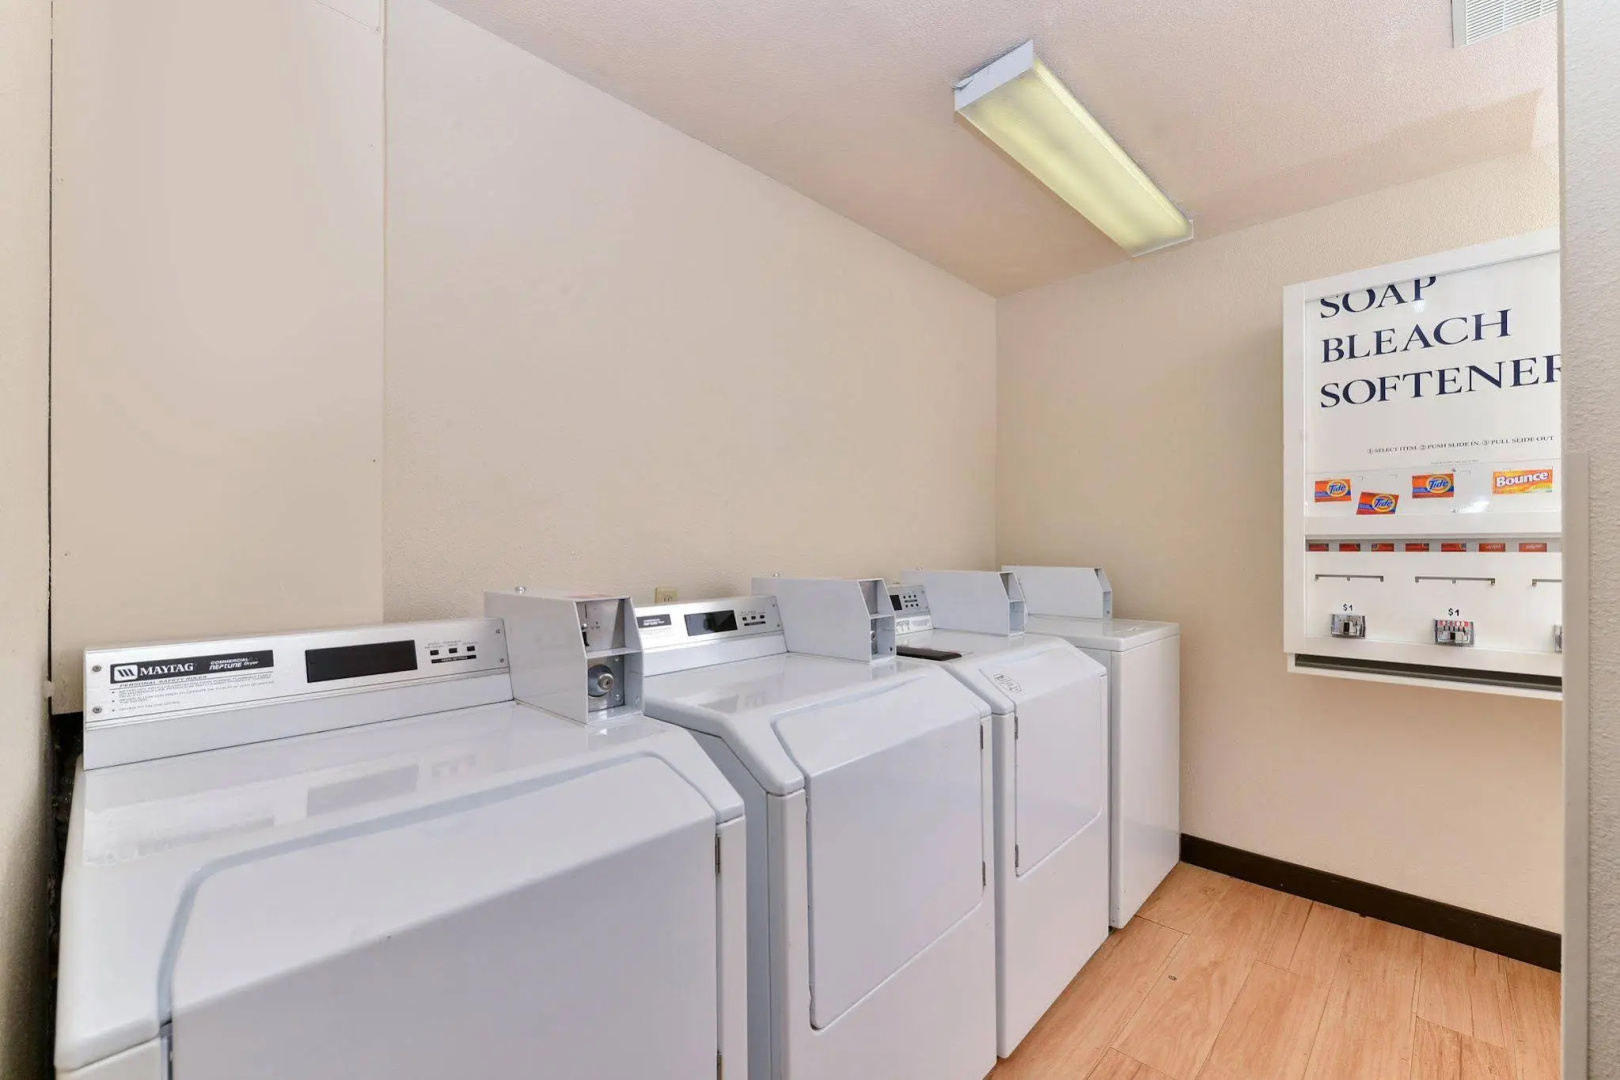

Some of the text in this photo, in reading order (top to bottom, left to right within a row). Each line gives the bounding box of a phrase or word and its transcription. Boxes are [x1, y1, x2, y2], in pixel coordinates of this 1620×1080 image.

[1320, 276, 1437, 319] SOAP
[1321, 309, 1512, 364] BLEACH
[1374, 446, 1398, 454] SELECT
[1448, 441, 1469, 449] SLIDE
[1428, 478, 1449, 490] Tide
[1495, 471, 1549, 488] Bounce
[1329, 484, 1347, 495] Tide
[1373, 497, 1393, 508] Tide
[1342, 603, 1353, 612] $1
[1447, 607, 1460, 617] $1
[140, 662, 194, 676] MAYTAG
